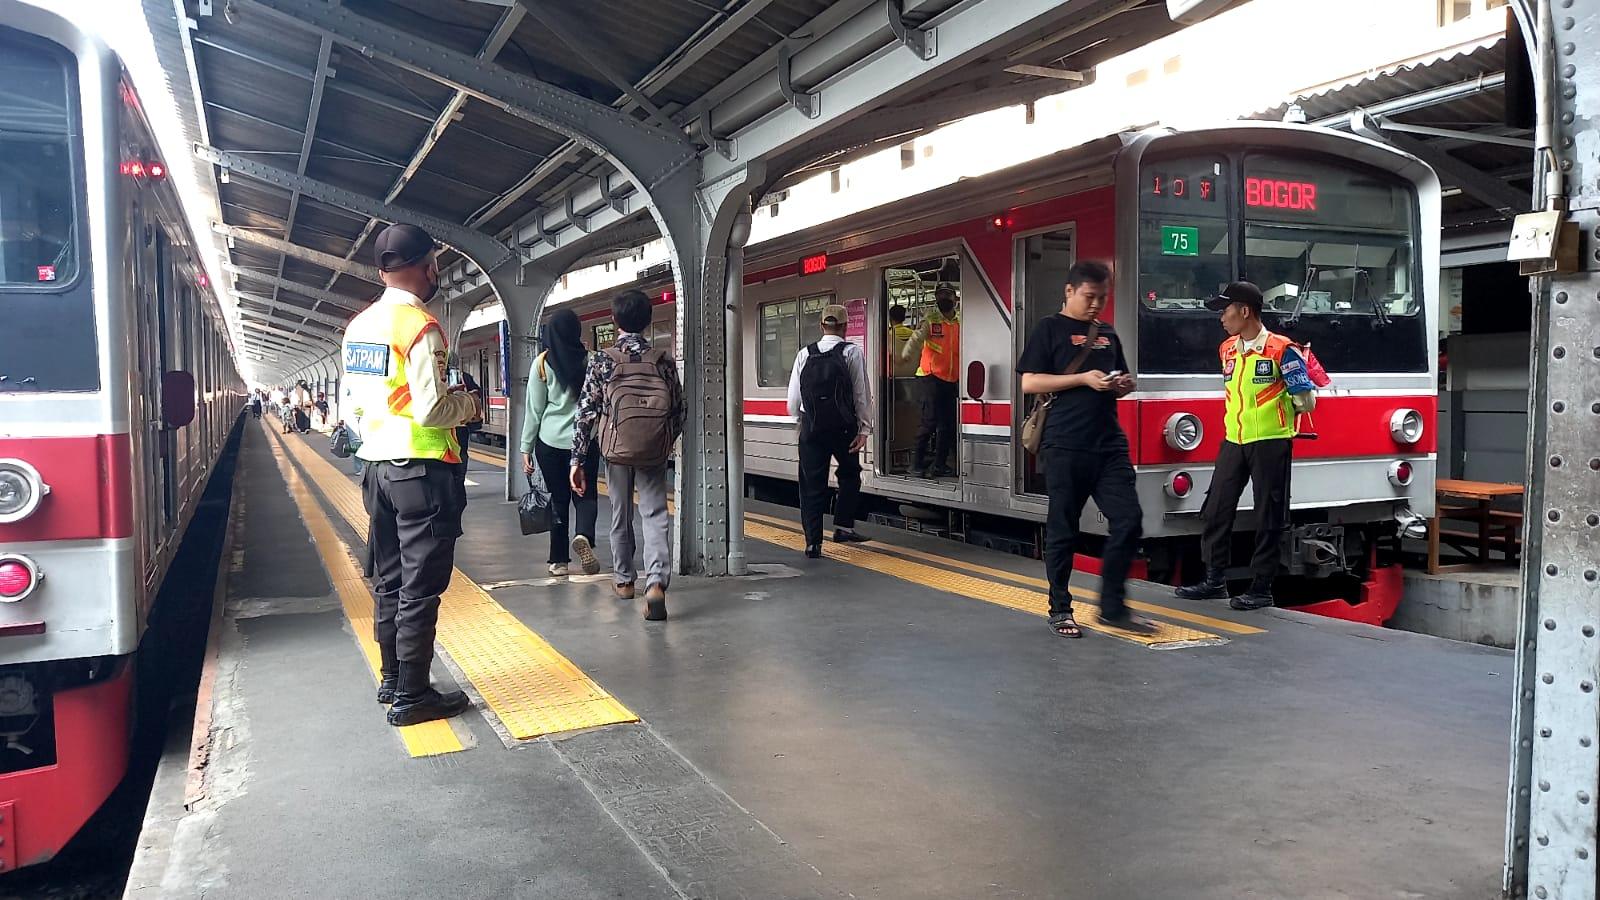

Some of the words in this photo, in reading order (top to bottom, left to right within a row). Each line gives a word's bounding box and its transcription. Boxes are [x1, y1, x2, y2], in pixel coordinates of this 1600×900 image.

[1246, 178, 1316, 210] BOGOR
[1171, 233, 1188, 250] 75
[804, 255, 826, 274] BOGOR
[346, 347, 384, 369] SATPAM
